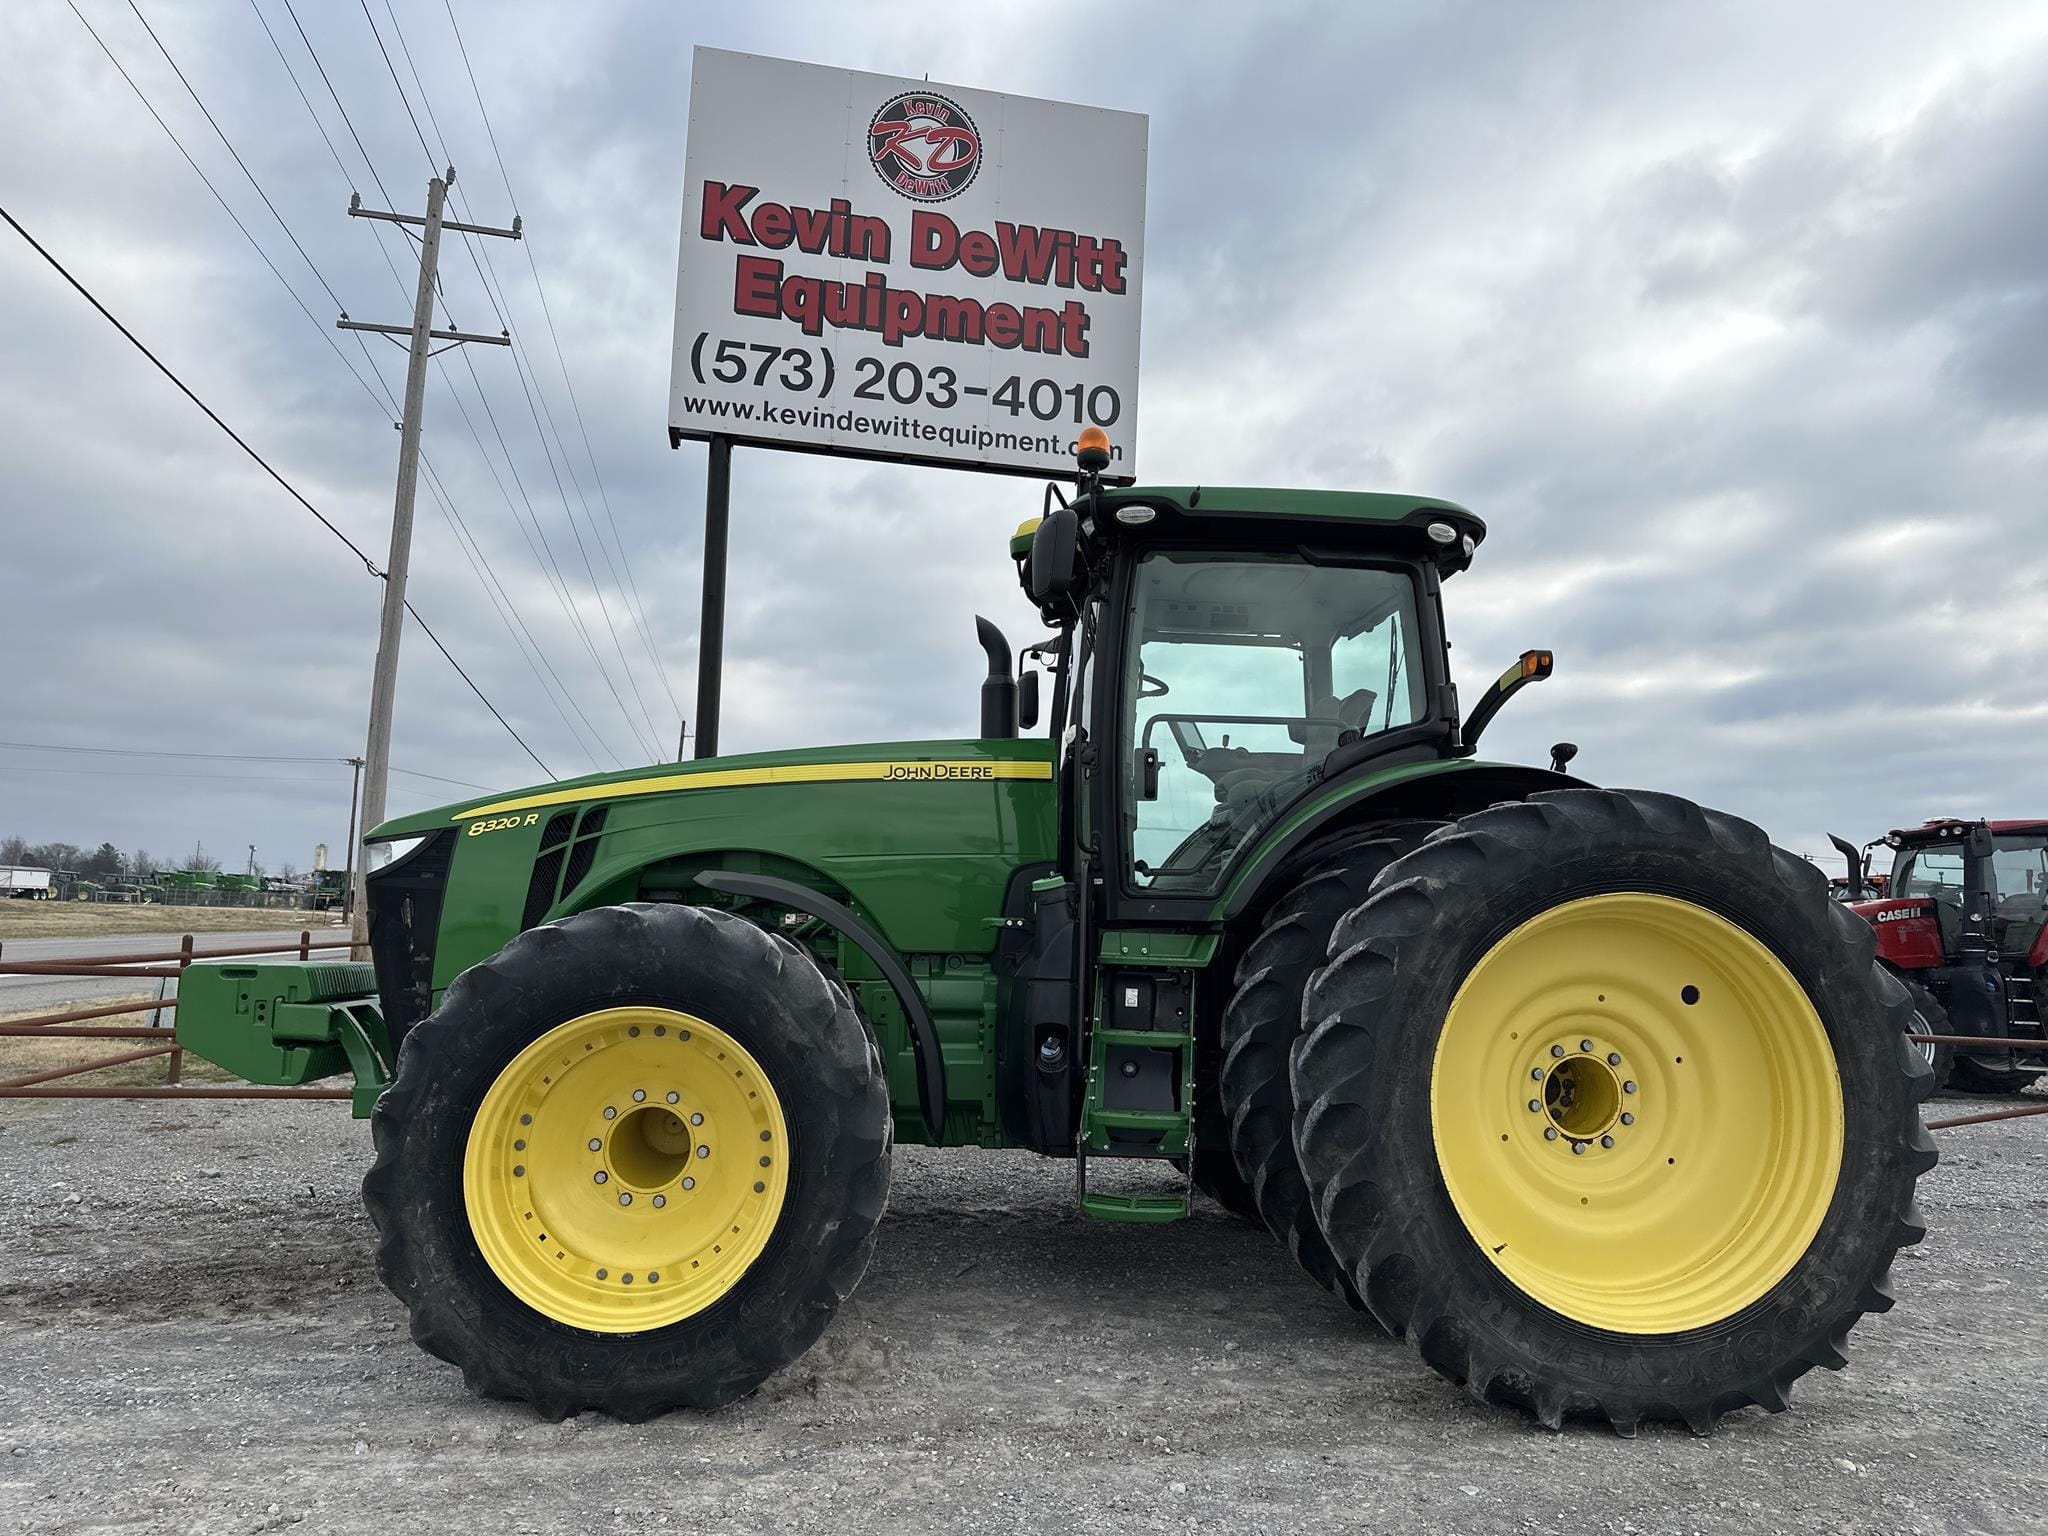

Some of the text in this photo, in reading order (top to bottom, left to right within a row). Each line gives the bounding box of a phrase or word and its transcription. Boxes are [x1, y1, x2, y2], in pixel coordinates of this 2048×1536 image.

[902, 100, 951, 121] Kevin
[871, 120, 979, 171] KD
[894, 171, 951, 196] DeWitt
[700, 180, 1127, 295] Kevin DeWitt
[734, 255, 1090, 358] Equipment
[690, 332, 1121, 427] (573) 203-4010
[683, 396, 1123, 461] www.kevindewittequipment.cm
[468, 813, 539, 837] 8320 R
[1877, 908, 1909, 922] CASE
